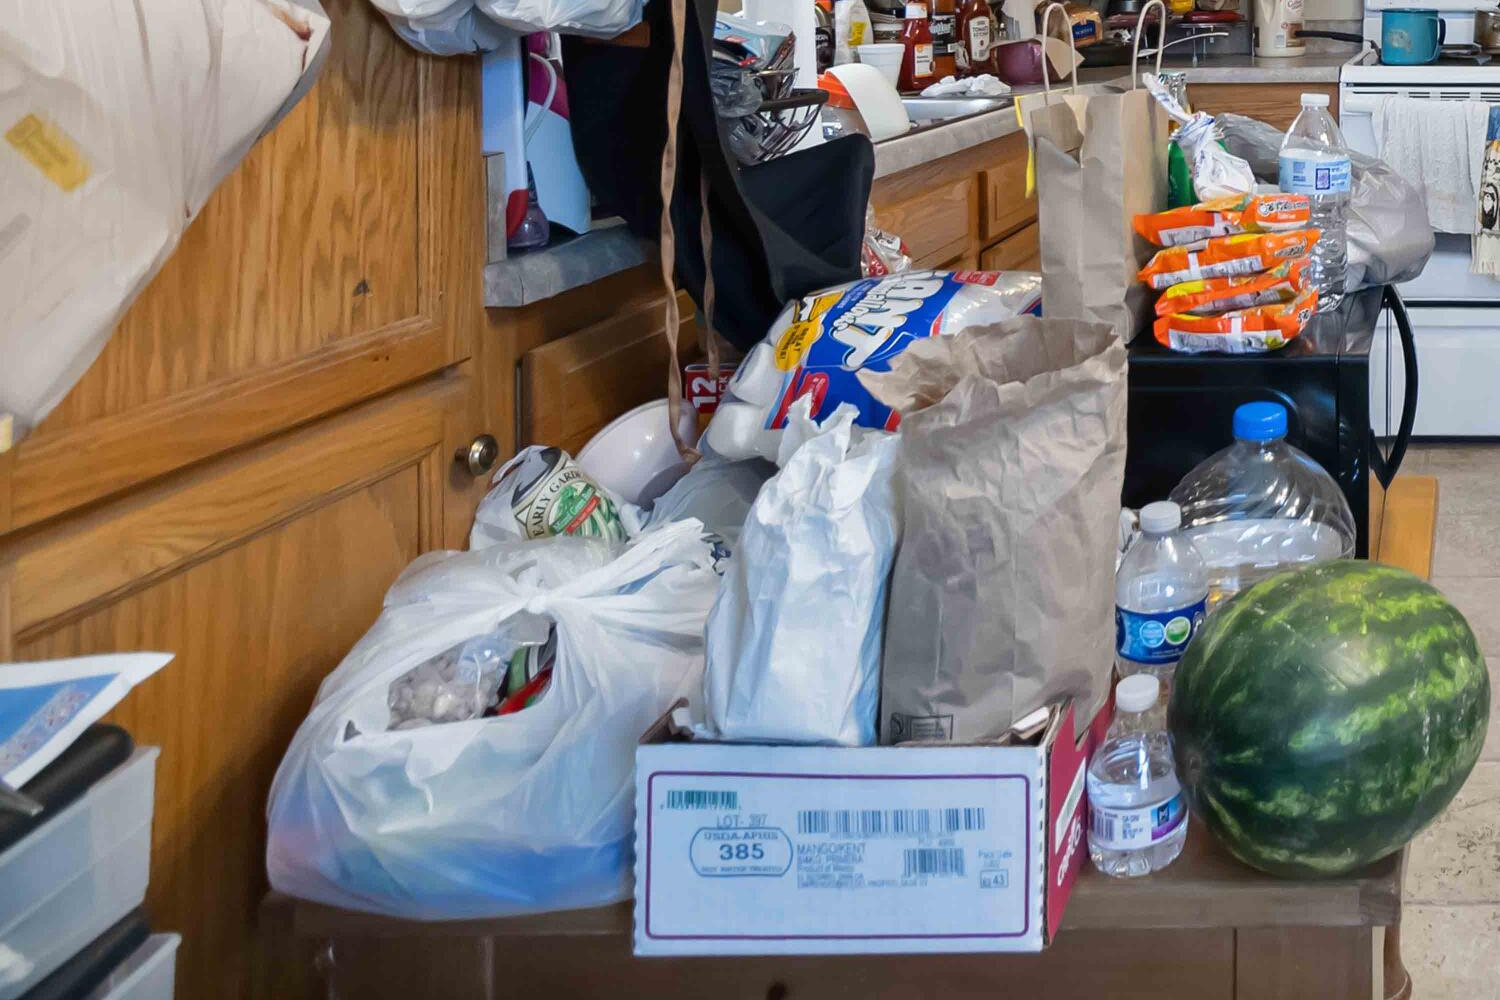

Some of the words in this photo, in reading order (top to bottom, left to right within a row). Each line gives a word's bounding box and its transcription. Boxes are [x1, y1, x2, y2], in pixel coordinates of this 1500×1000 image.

[692, 376, 717, 408] 12
[533, 498, 551, 537] EARLY
[719, 843, 765, 861] 385
